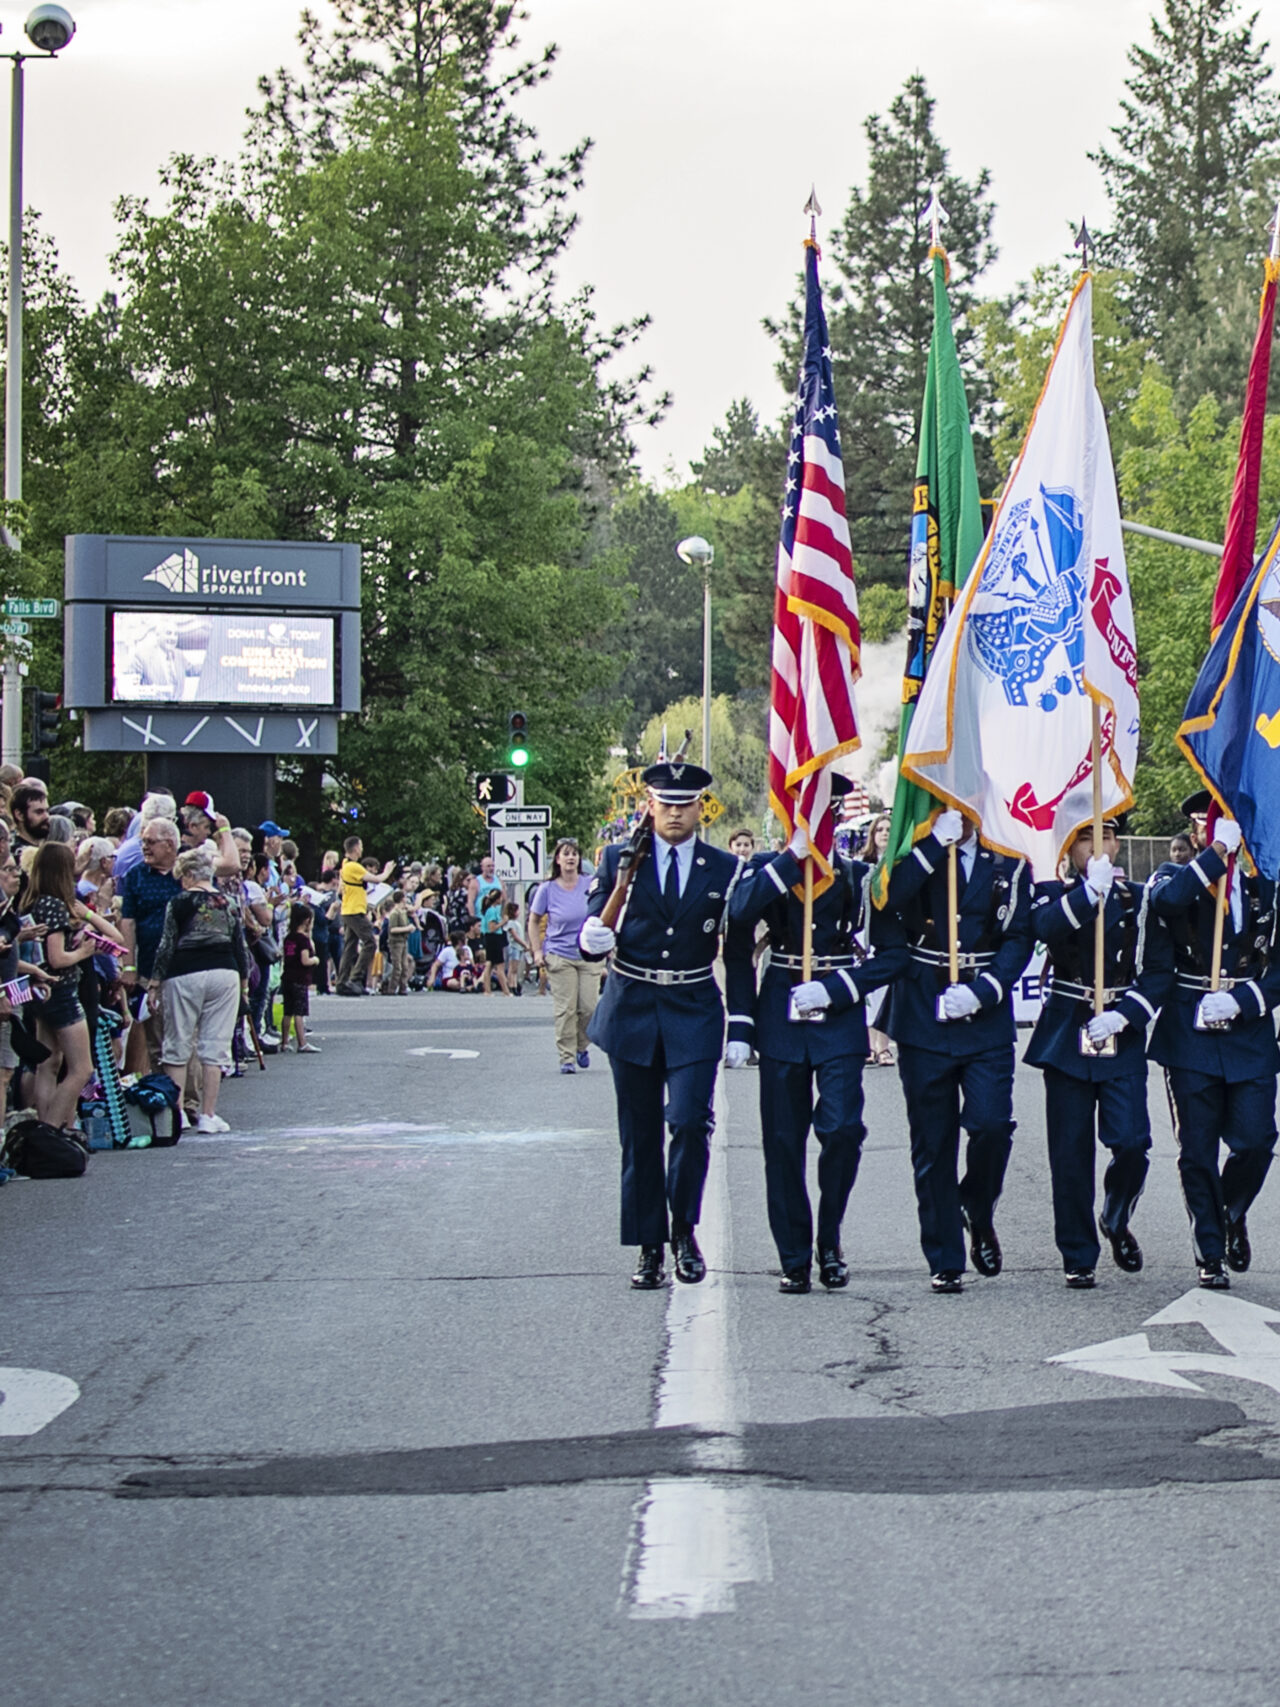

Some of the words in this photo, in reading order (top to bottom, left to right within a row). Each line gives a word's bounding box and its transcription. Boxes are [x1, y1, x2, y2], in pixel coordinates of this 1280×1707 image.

[202, 565, 307, 587] riverfront
[202, 584, 263, 596] SPOKANE
[9, 601, 30, 613] Falls
[33, 601, 54, 613] Blvd
[227, 628, 266, 640] DONATE
[289, 629, 322, 641] TODAY
[505, 813, 521, 821] ONE
[526, 813, 543, 821] WAY
[496, 869, 518, 878] ONLY
